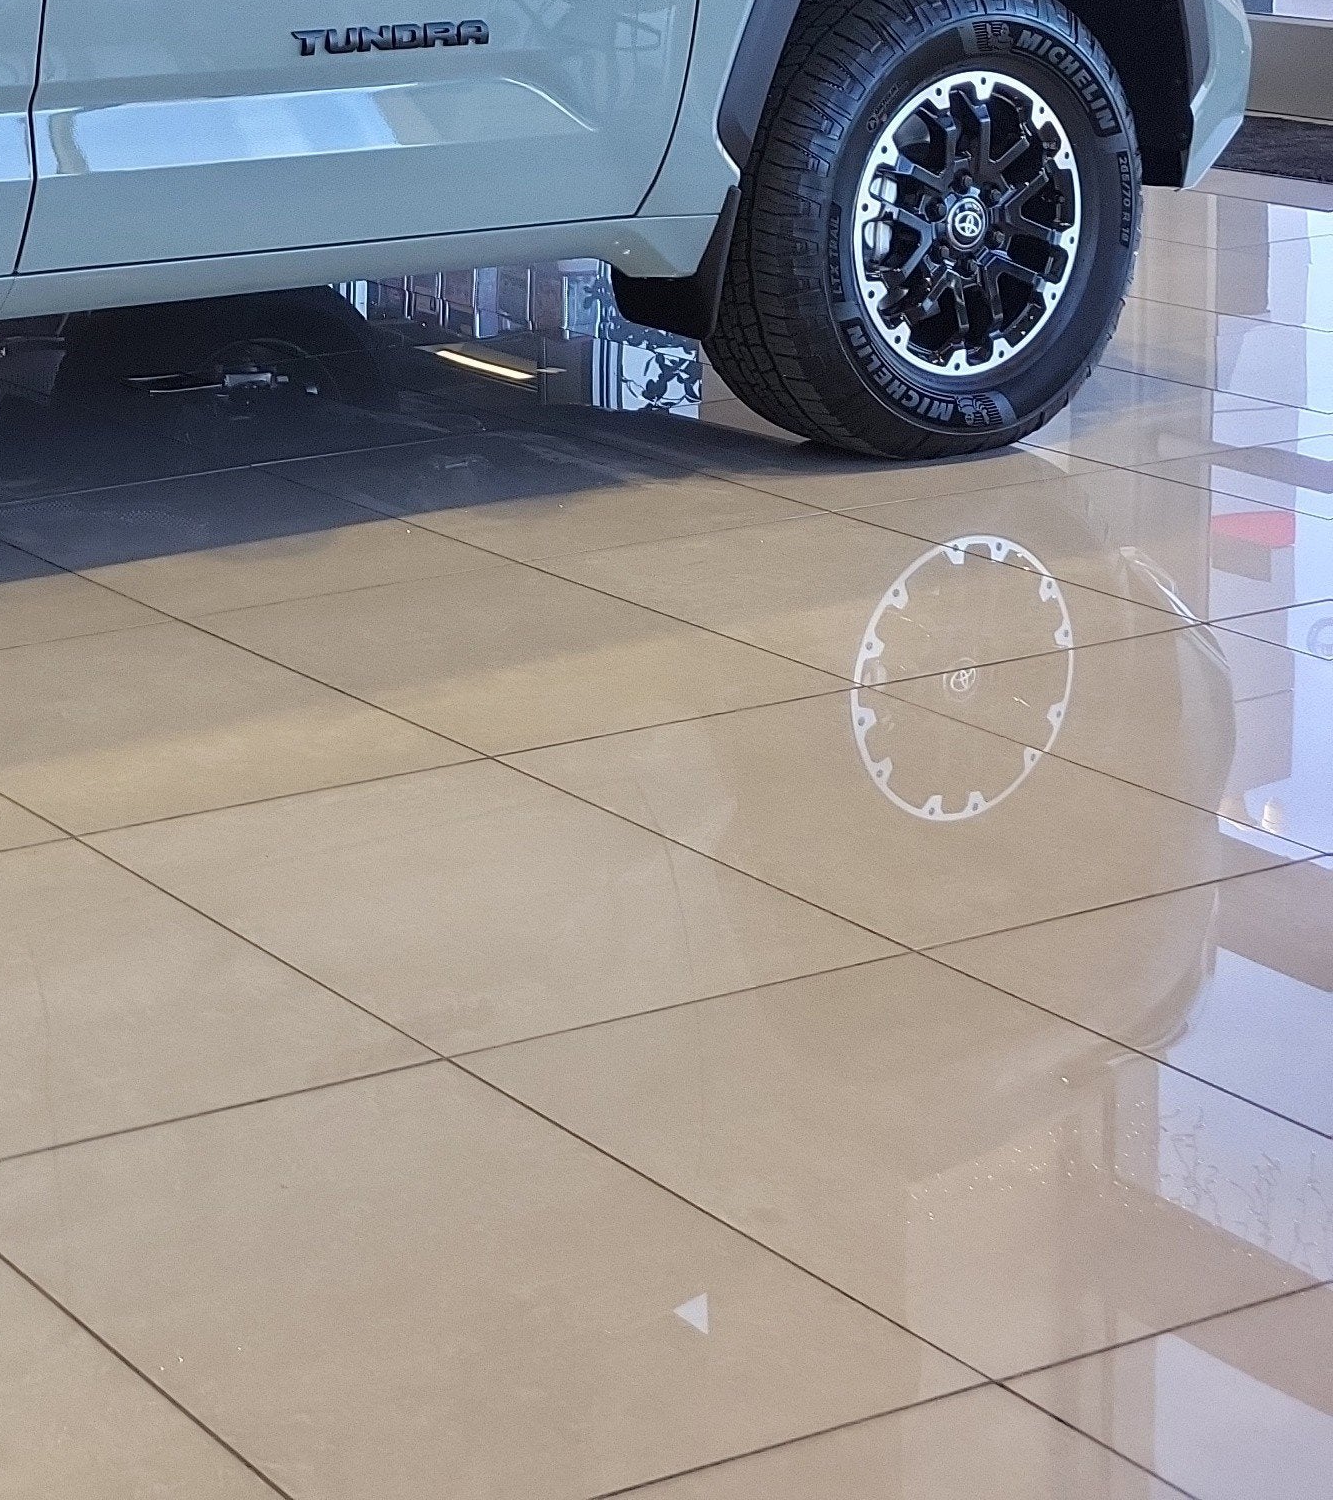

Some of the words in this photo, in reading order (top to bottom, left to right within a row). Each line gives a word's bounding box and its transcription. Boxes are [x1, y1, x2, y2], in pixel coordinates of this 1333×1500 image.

[291, 19, 489, 56] TUNDRA
[1017, 29, 1116, 130] MICHELIN
[846, 325, 954, 422] MICHELIN
